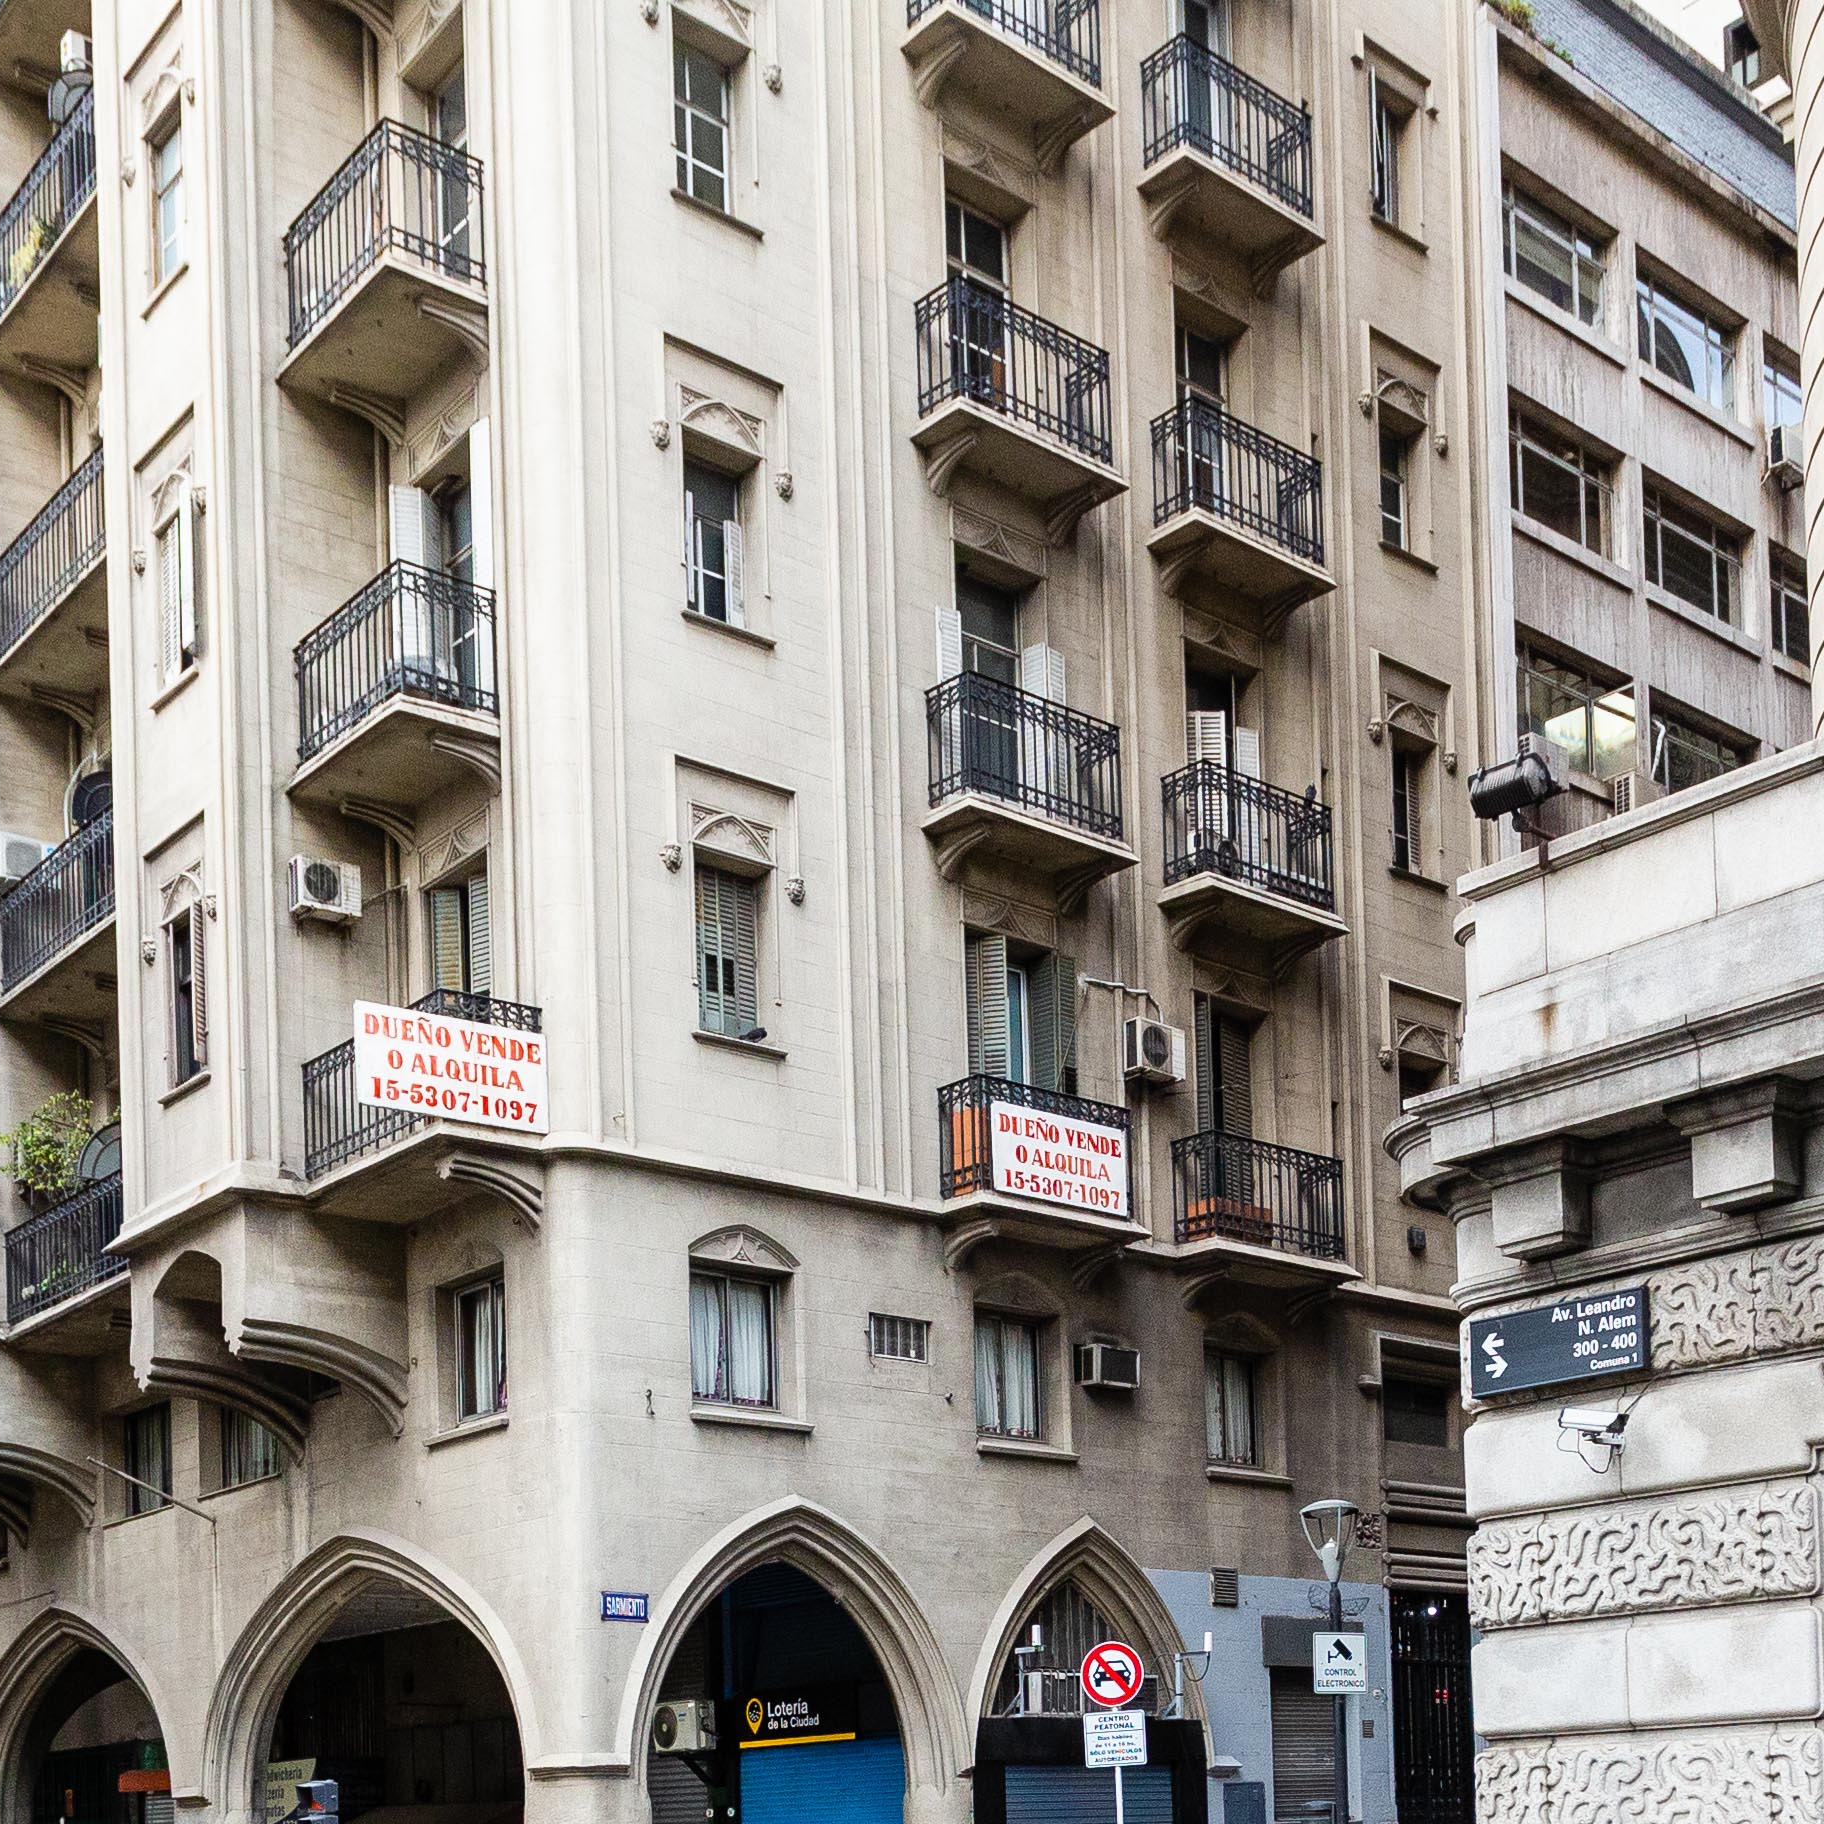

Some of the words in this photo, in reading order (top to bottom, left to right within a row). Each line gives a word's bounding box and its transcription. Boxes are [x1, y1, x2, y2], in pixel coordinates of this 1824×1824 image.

[364, 1013, 451, 1048] DUEÑO
[460, 1029, 542, 1065] VENDE
[387, 1049, 403, 1069] O
[412, 1053, 525, 1091] ALQUILA
[371, 1076, 538, 1124] 15-5307-1097
[999, 1112, 1060, 1144] DUEÑO
[1065, 1127, 1122, 1158] VENDE
[1015, 1144, 1028, 1164] O
[1031, 1148, 1111, 1182] ALQUILA
[1004, 1168, 1120, 1210] 15-5307-1097
[1551, 1307, 1574, 1323] Av.
[1576, 1294, 1636, 1318] Leandro
[1578, 1321, 1594, 1337] N.
[1598, 1314, 1637, 1333] Alem
[1573, 1339, 1600, 1358] 300
[1610, 1332, 1638, 1351] 400
[1589, 1355, 1630, 1371] Comuna
[1632, 1351, 1639, 1364] 1
[606, 1596, 645, 1617] SARMIENTO
[1317, 1679, 1365, 1688] ELECTRONICO
[1324, 1668, 1357, 1677] CONTROL
[767, 1697, 809, 1718] Lotería
[1098, 1715, 1130, 1723] CENTRO
[767, 1718, 779, 1730] de
[780, 1717, 789, 1729] la
[790, 1713, 820, 1728] Ciudad
[1094, 1722, 1135, 1730] PEATONAL
